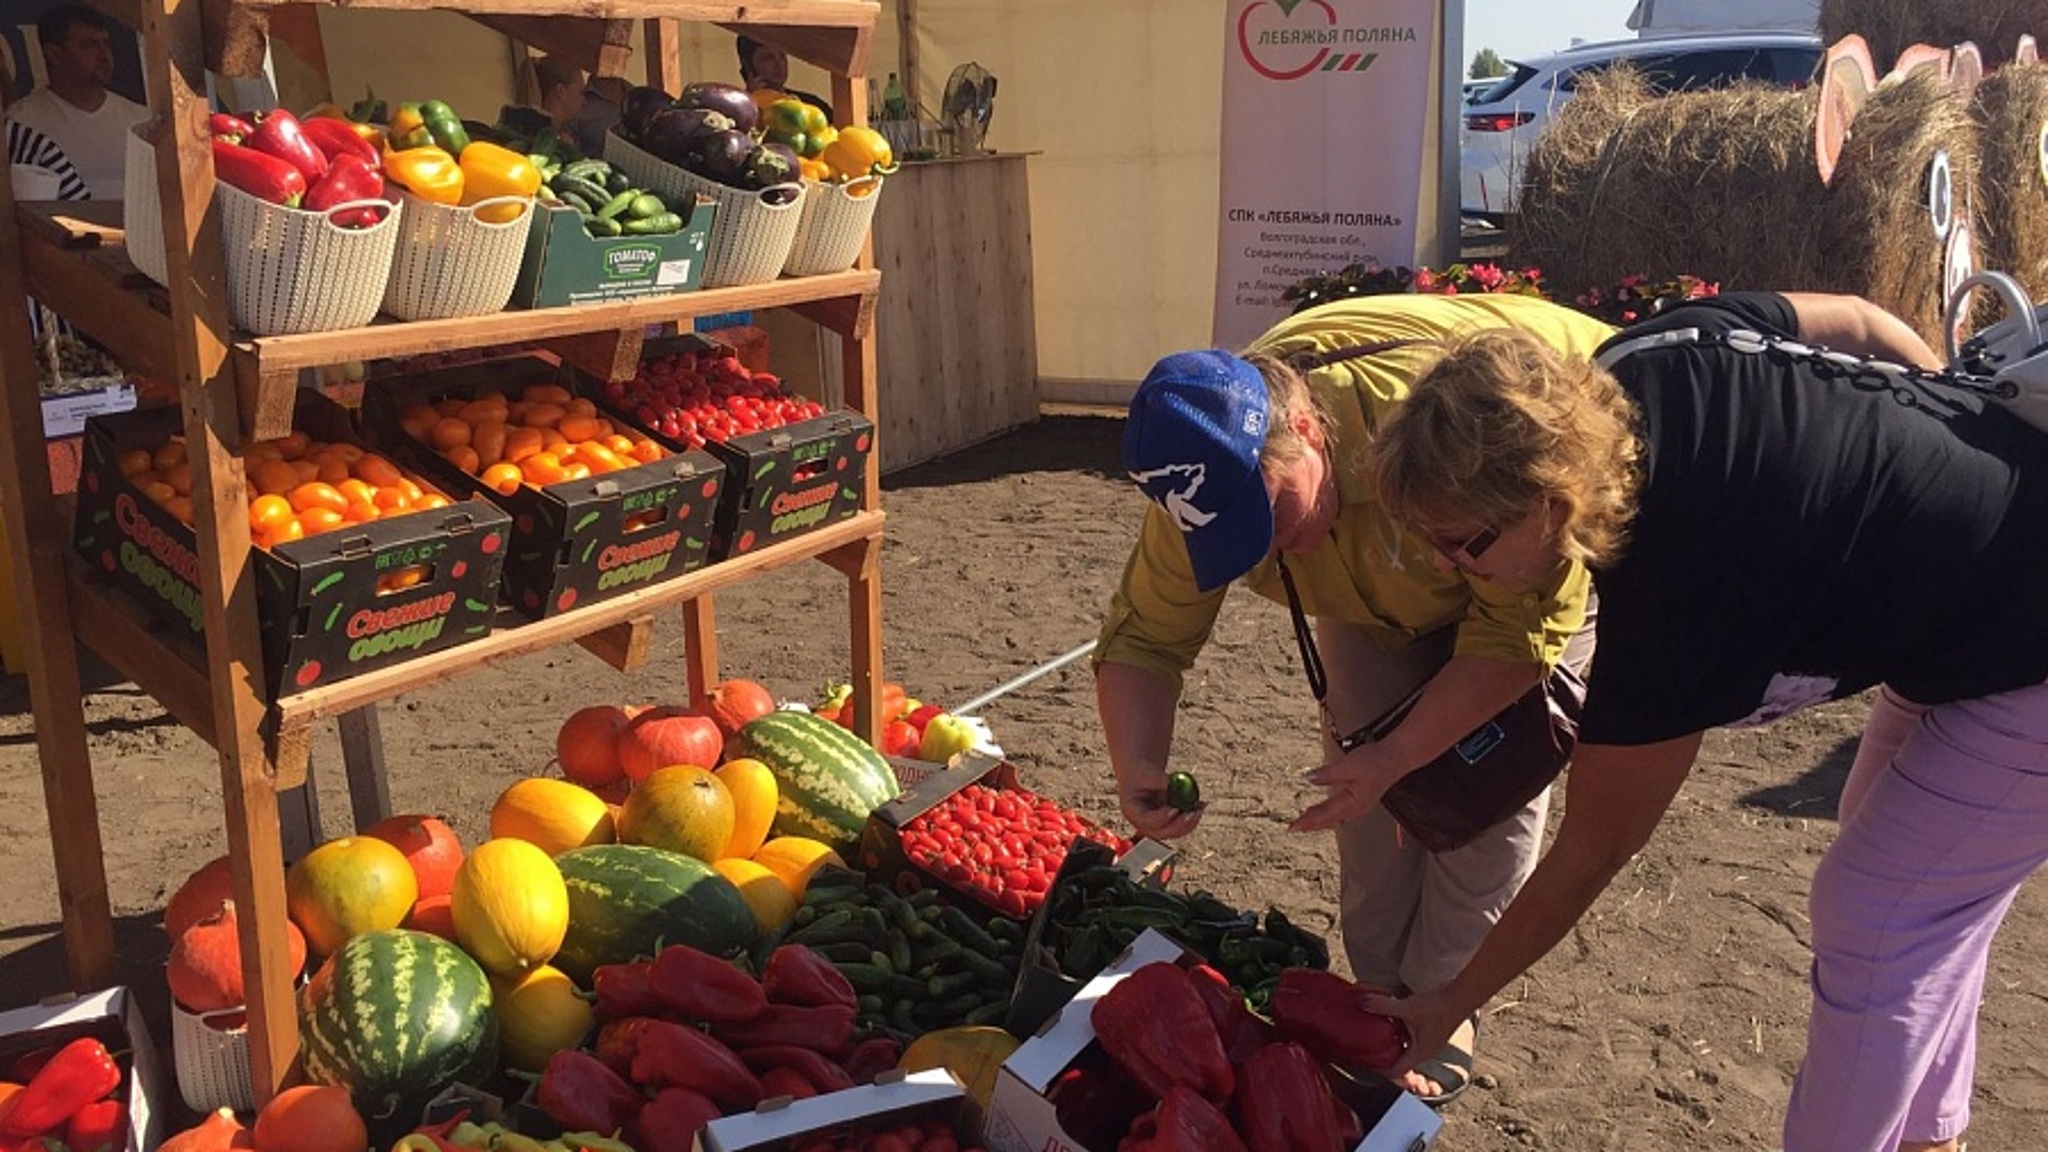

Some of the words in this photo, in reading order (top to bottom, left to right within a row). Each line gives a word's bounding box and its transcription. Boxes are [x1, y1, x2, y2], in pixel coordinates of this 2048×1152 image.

[1257, 28, 1338, 46] ЛЕБЯЖЬЯ
[1342, 26, 1417, 43] ПОЛЯНА
[1228, 208, 1256, 222] СПК
[1258, 210, 1331, 226] «ЛЕБЯЖЬЯ
[1260, 231, 1337, 245] Волгоградская
[346, 591, 456, 638] Свежие
[348, 616, 447, 662] овощи
